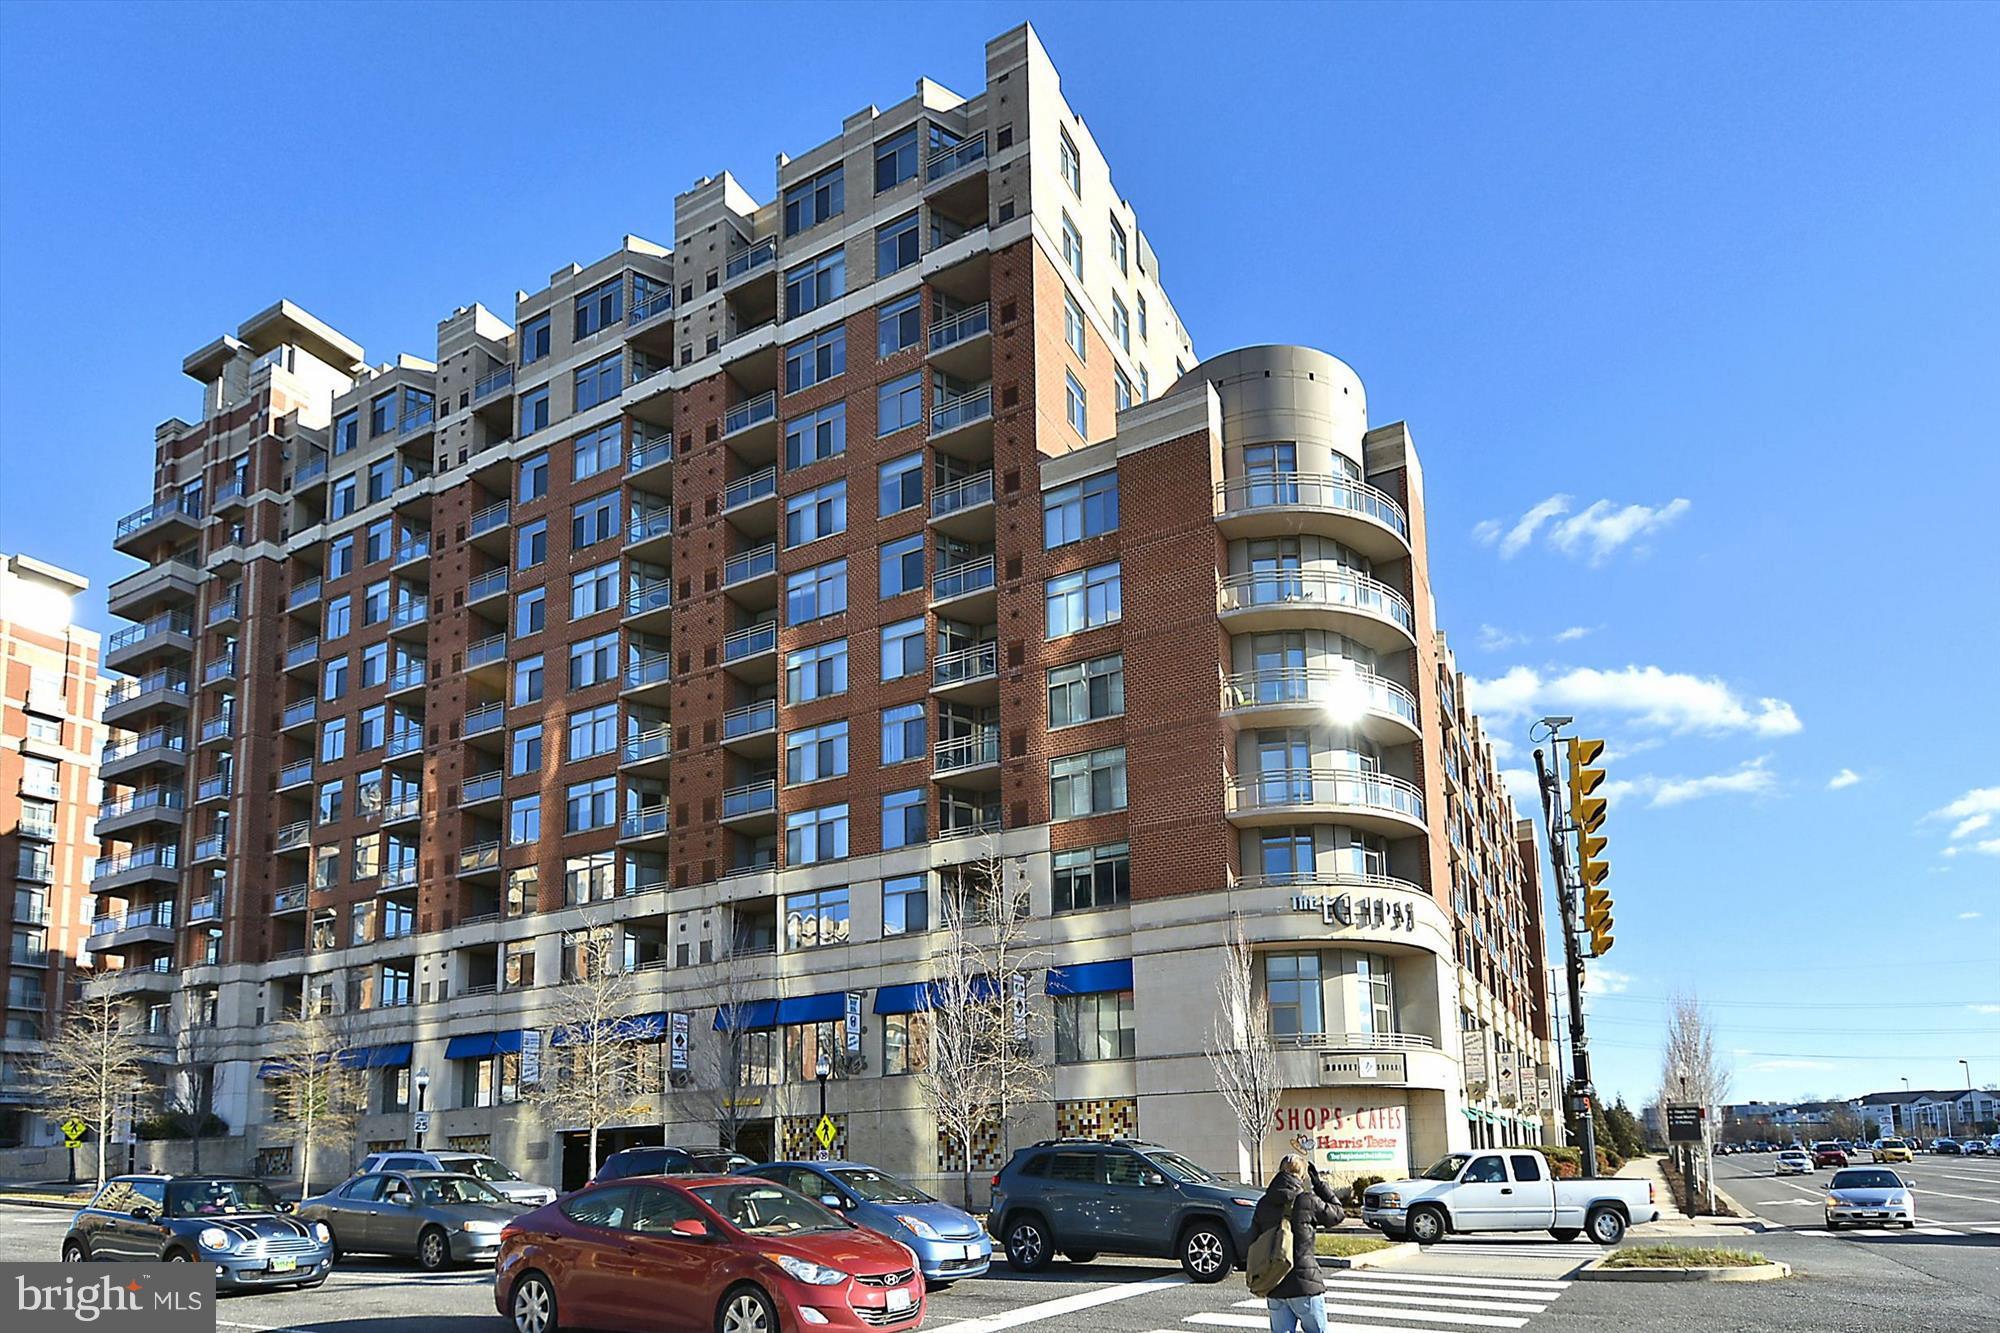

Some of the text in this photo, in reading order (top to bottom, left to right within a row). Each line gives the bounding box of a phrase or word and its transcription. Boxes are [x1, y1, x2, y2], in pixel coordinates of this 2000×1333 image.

[416, 1122, 428, 1130] 25
[1275, 1107, 1401, 1131] SHOPS CAFES
[1316, 1135, 1397, 1149] Harris Teeter
